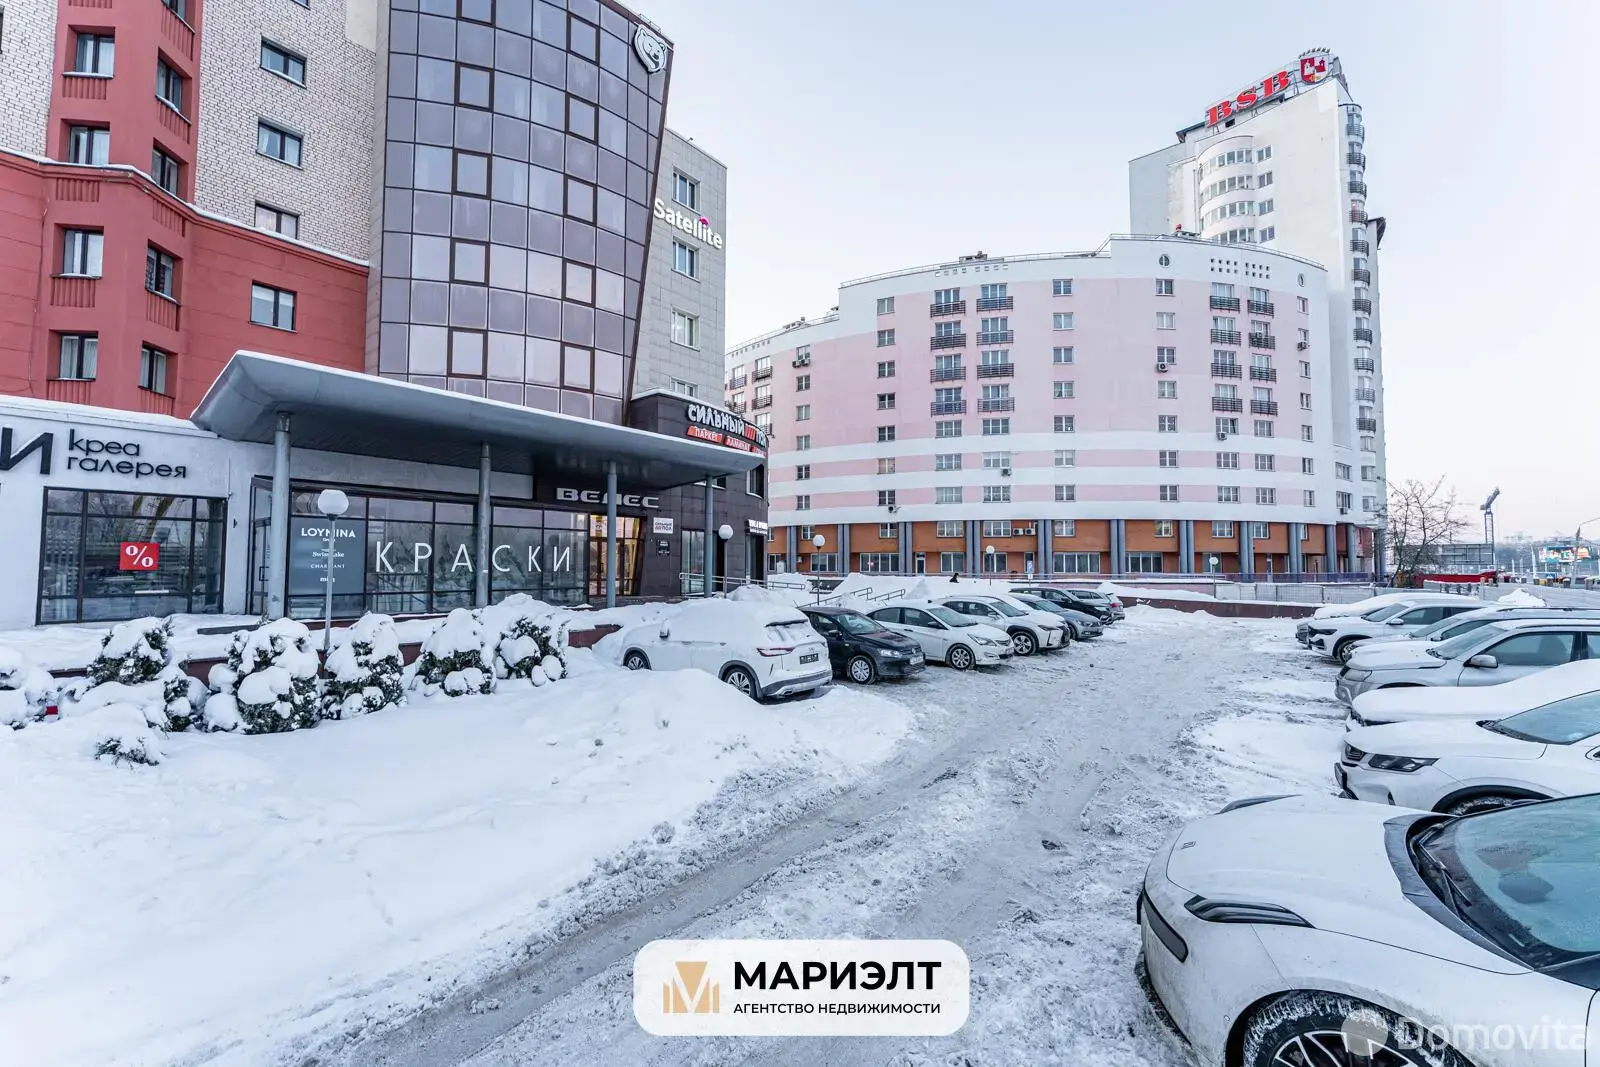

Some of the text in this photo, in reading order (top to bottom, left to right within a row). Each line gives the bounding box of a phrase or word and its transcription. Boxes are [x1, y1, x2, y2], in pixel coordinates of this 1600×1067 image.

[1206, 71, 1290, 127] BSB
[653, 198, 723, 249] Satellite
[688, 404, 745, 436] СИЛЬНЫЙ
[695, 428, 718, 441] ПАРКЕТ
[68, 428, 141, 456] креа
[67, 457, 187, 478] галерея
[556, 487, 660, 509] ВЕЛЕС
[375, 541, 570, 573] КРАСКИ
